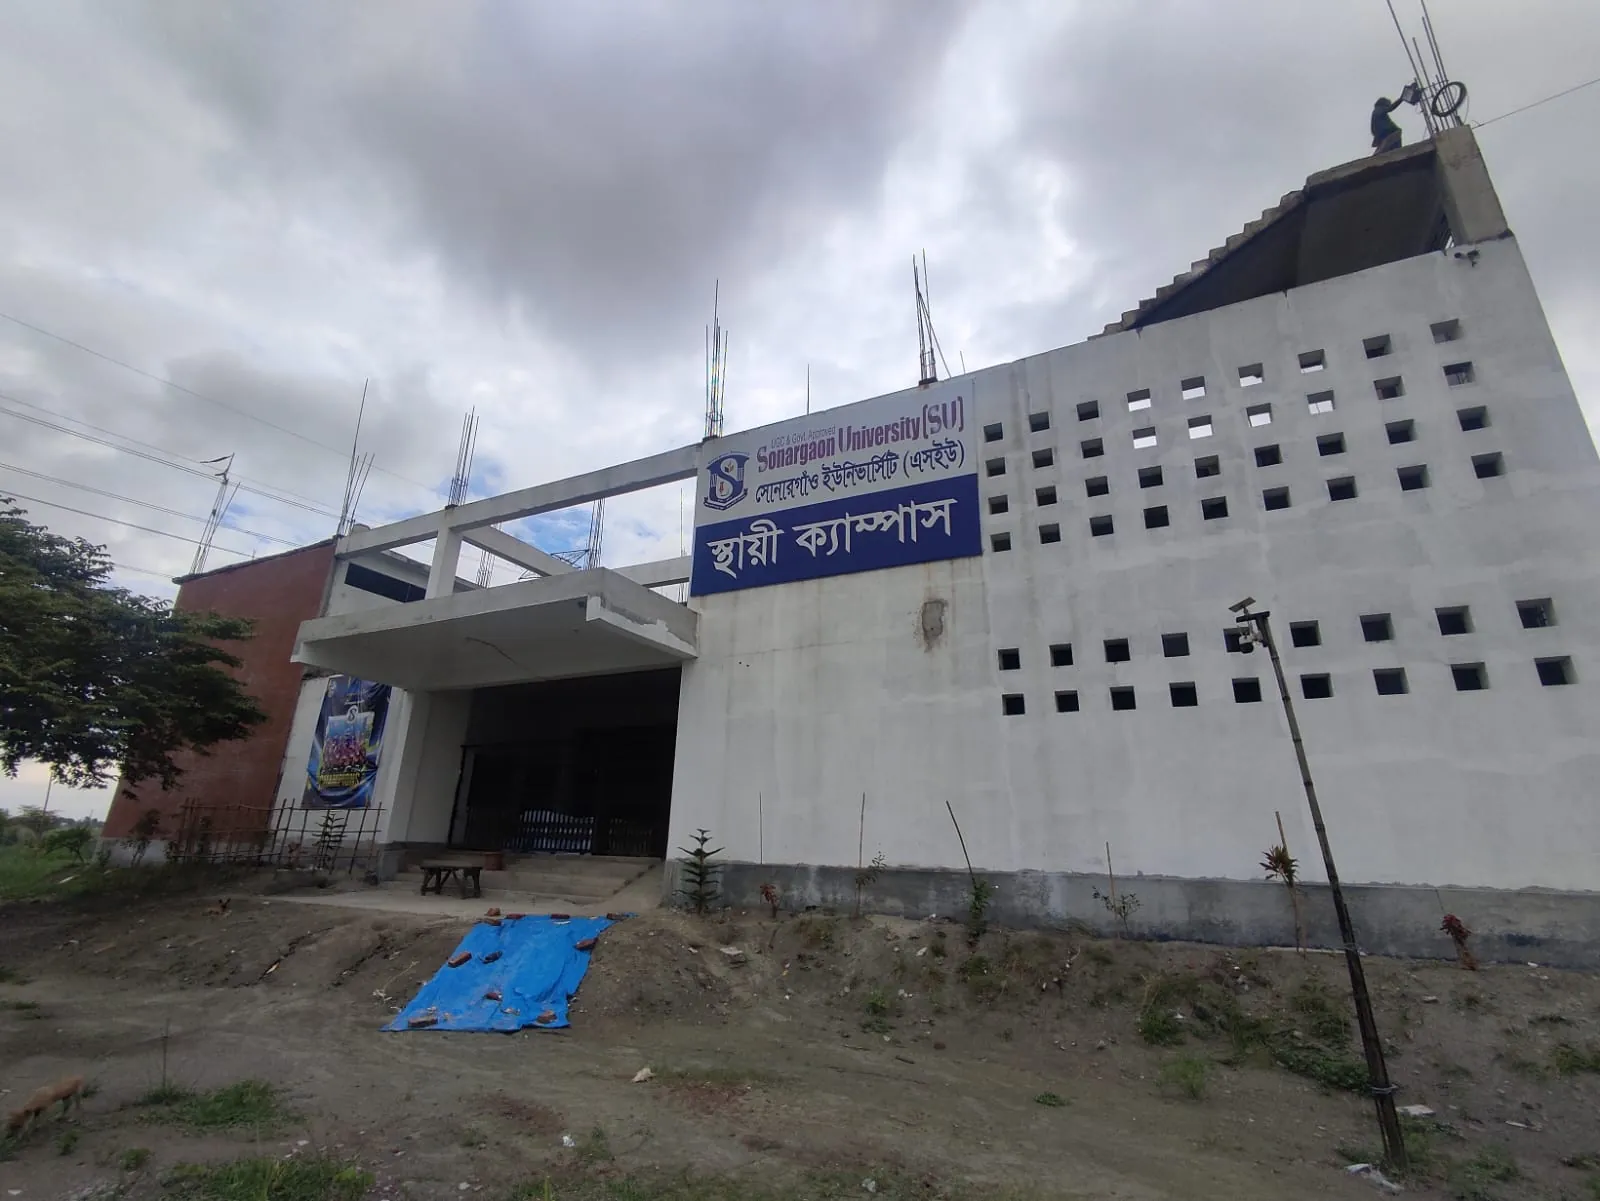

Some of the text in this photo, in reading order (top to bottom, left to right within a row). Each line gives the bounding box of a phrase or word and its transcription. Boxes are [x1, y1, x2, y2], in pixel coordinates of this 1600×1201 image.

[757, 437, 835, 473] Sonargaon
[838, 415, 921, 453] University
[755, 470, 819, 504] সোনারগাঁও
[821, 450, 900, 493] ইউনিভার্সিটি
[791, 498, 958, 558] ক্যাম্পাস
